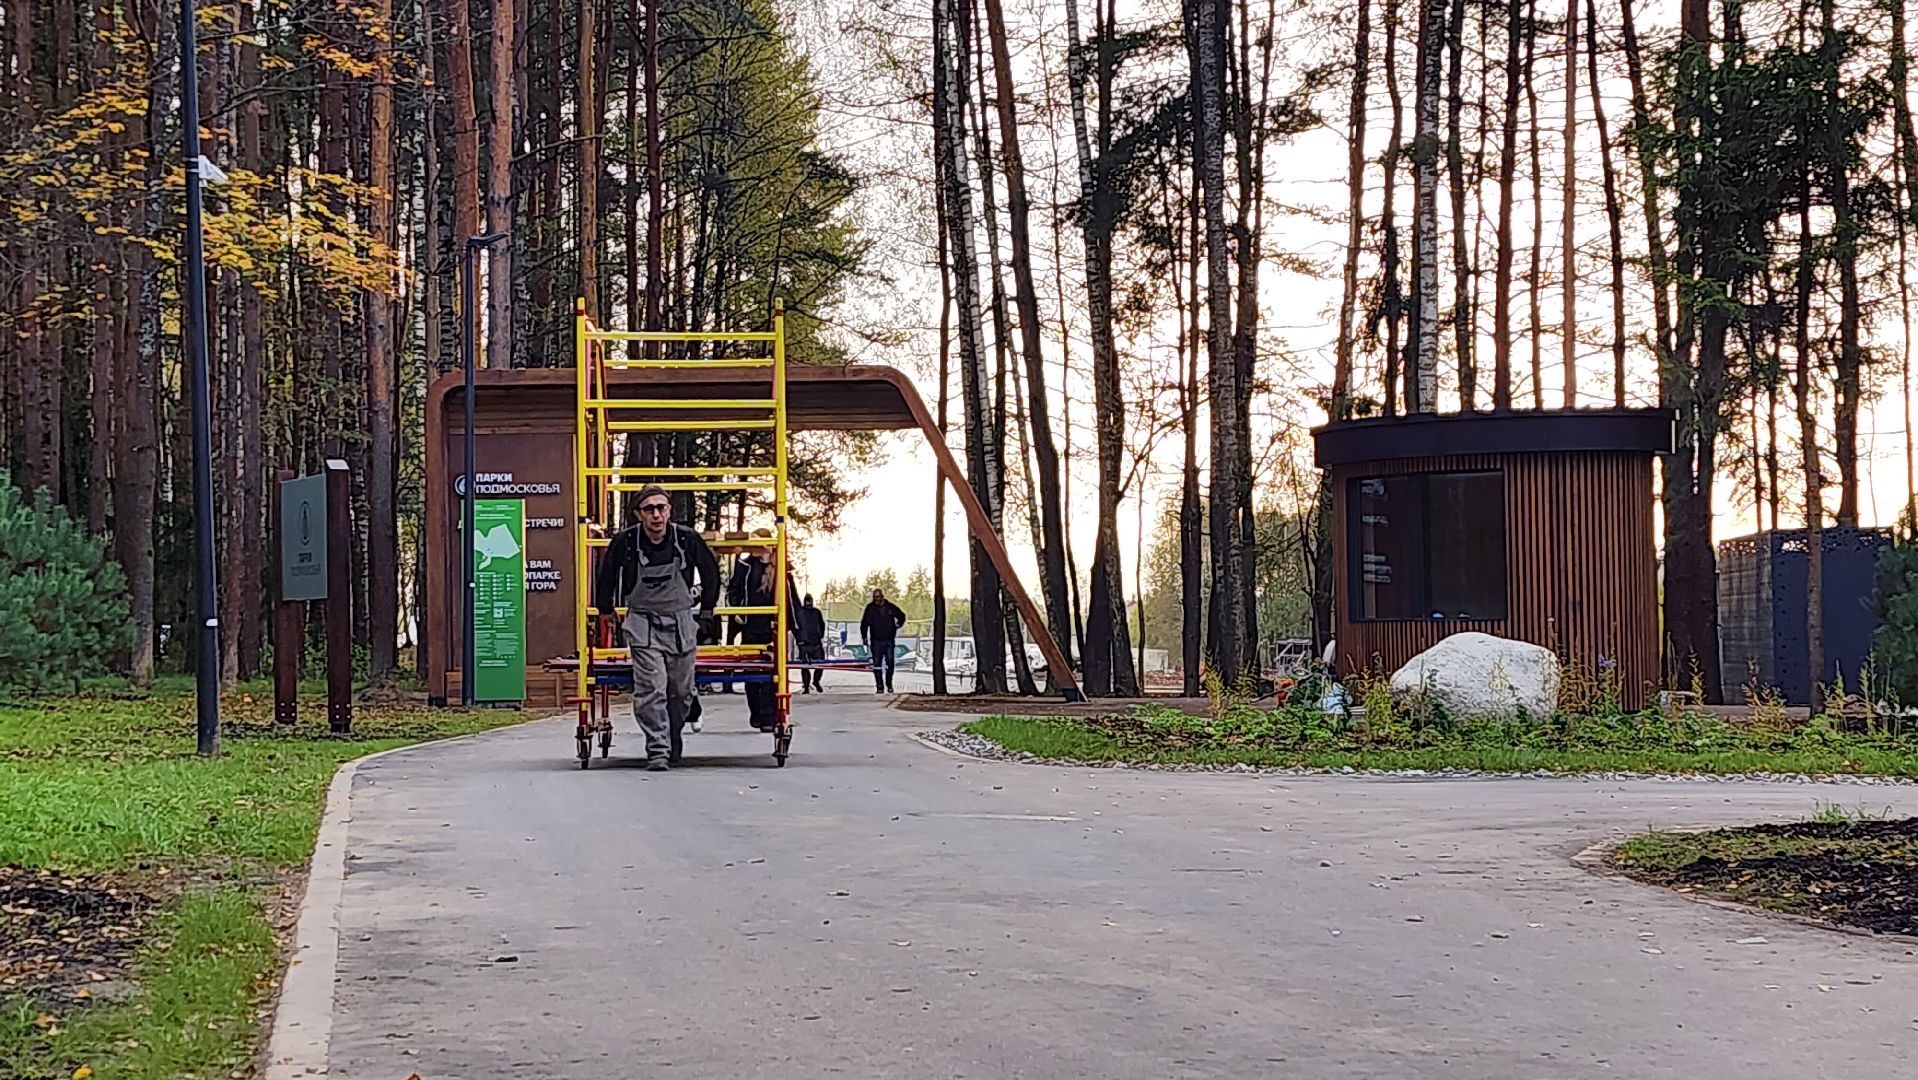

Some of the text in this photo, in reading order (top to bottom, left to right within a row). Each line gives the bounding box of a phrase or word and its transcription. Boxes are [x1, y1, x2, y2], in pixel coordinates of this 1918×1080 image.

[475, 473, 512, 482] ПАРКИ
[475, 483, 560, 494] ПОДМОСКОВЬЯ
[525, 518, 564, 528] СТРЕЧИ!
[529, 560, 551, 568] ВАМ
[531, 582, 557, 590] ГОРА
